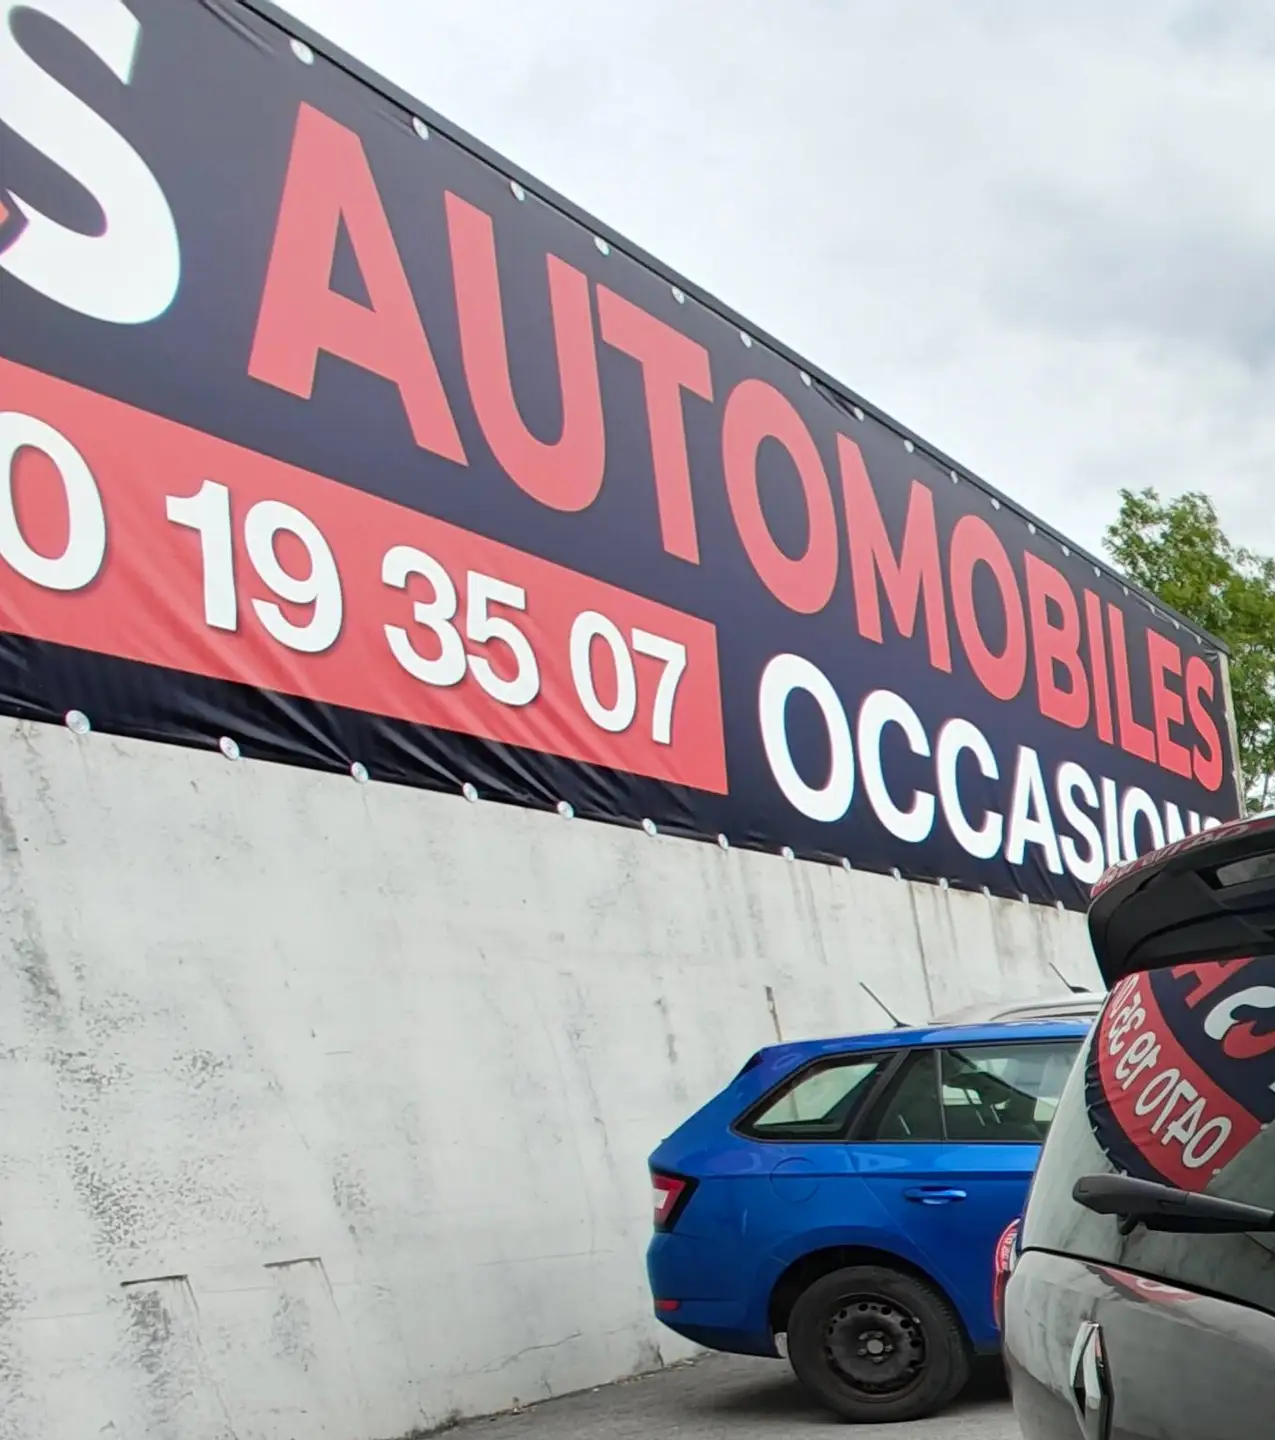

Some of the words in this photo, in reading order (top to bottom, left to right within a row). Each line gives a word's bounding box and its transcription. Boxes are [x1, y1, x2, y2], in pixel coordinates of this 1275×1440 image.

[248, 100, 1224, 793] AUTOMOBILES
[165, 479, 344, 653] 19
[381, 545, 540, 707] 35
[569, 610, 687, 745] 07
[758, 652, 1222, 884] OCCASIO
